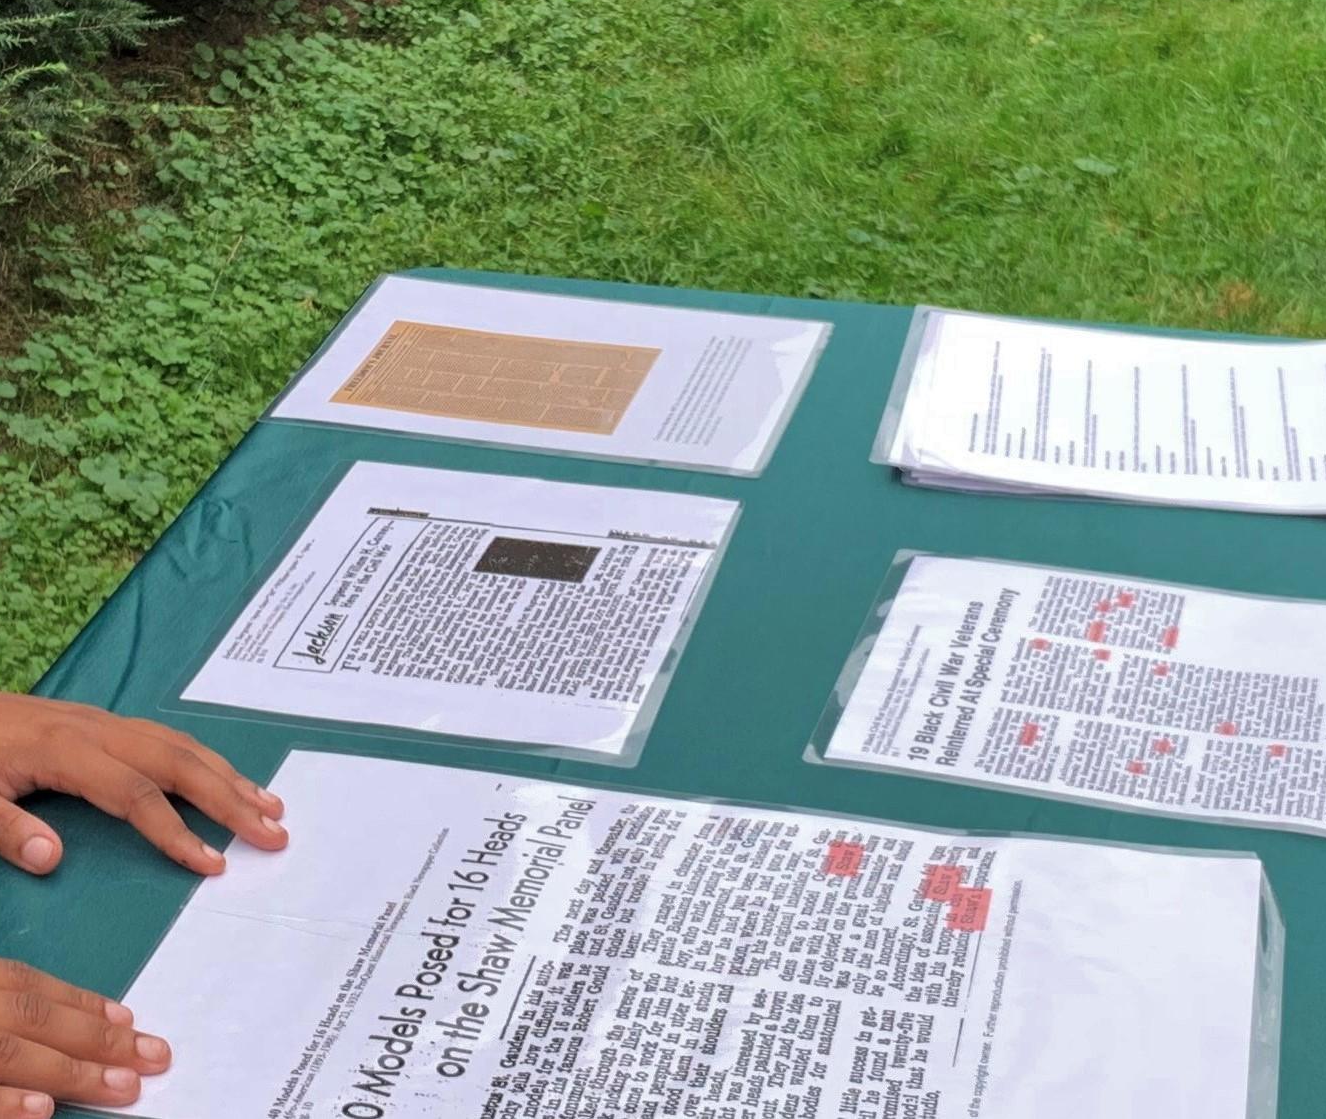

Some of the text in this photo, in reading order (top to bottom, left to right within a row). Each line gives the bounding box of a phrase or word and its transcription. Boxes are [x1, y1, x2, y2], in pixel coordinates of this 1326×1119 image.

[293, 613, 347, 664] Jackson
[907, 601, 983, 760] 19 Black Civil War Veterans
[936, 588, 1019, 766] Reinterred At Special Ceremony
[462, 813, 526, 865] Heads
[448, 871, 489, 891] 16
[428, 898, 475, 927] for
[436, 796, 596, 1077] on the Shaw Memorial Panel
[396, 932, 459, 999] Posed
[574, 964, 592, 976] he
[491, 960, 554, 1088] St. Gaudens in his auto-
[561, 980, 586, 1016] soldiers
[743, 1012, 763, 1025] by
[764, 991, 787, 1021] brown
[786, 993, 805, 1014] idea
[355, 1008, 425, 1096] Models
[509, 962, 574, 1093] tells how difficult it was
[542, 965, 610, 1111] in his famous Robert Gould
[544, 1037, 564, 1053] the
[588, 968, 644, 1089] through the streets of
[604, 973, 661, 1110] picking up likely men who
[623, 976, 679, 1114] come to work for him but
[641, 980, 695, 1118] and perspired in utter ter-
[662, 982, 715, 1115] stood them in his studio
[683, 984, 734, 1117] over their shoulders and
[774, 1038, 794, 1060] had
[780, 1017, 800, 1034] the
[790, 996, 823, 1085] wanted them to
[890, 1012, 914, 1068] twenty-five
[906, 1014, 934, 1089] that he would
[535, 1058, 555, 1075] for
[732, 1029, 757, 1077] increased
[754, 1033, 776, 1073] painted
[767, 1060, 790, 1088] They
[798, 999, 841, 1119] bodies for anatomical
[839, 1006, 877, 1114] little success in get-
[861, 1009, 896, 1105] he found a man
[523, 1080, 549, 1118] models
[703, 1069, 728, 1102] heads,
[726, 1081, 743, 1101] was
[741, 1075, 764, 1107] heads
